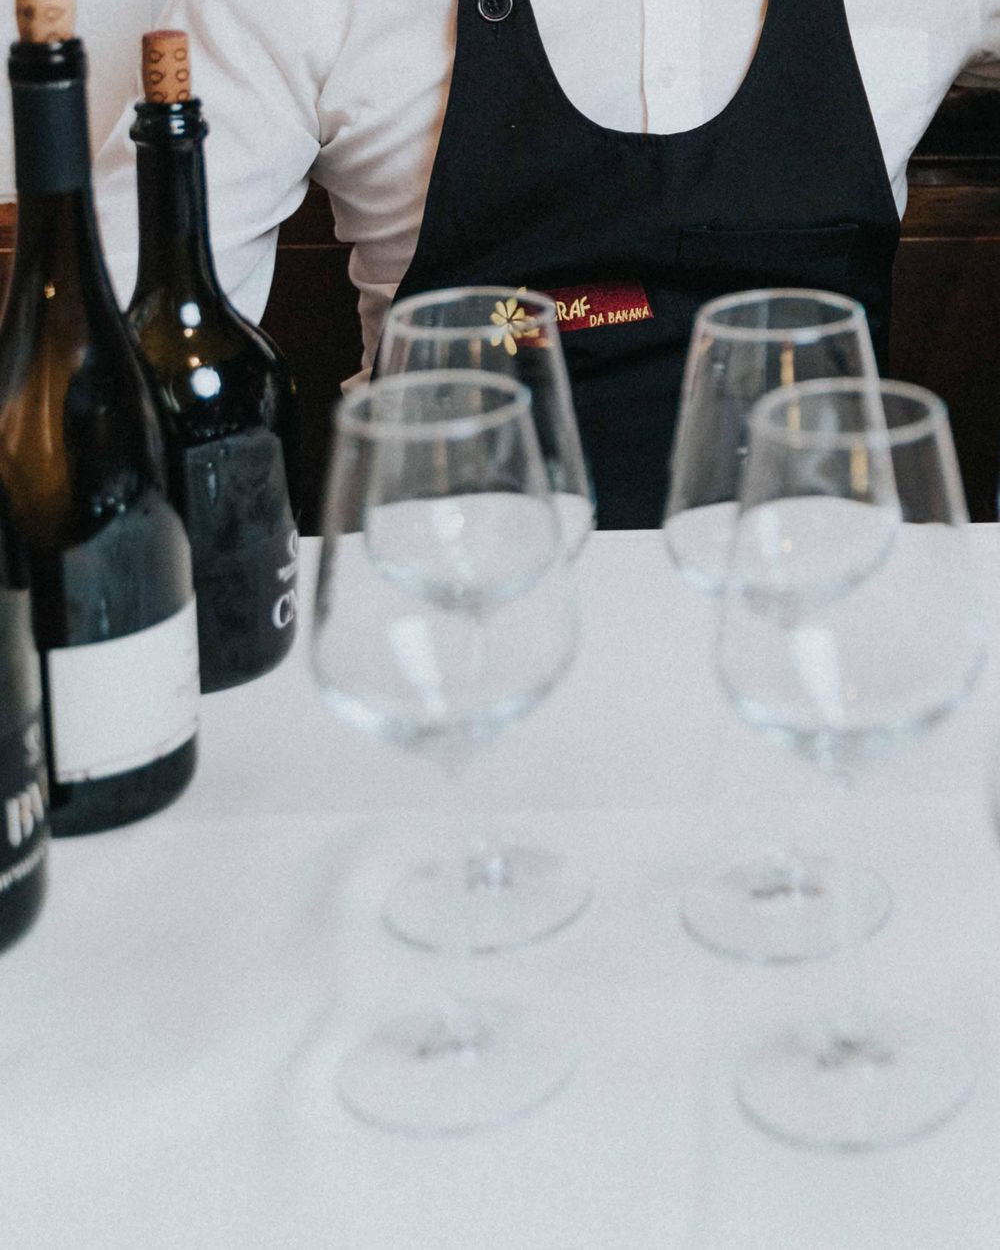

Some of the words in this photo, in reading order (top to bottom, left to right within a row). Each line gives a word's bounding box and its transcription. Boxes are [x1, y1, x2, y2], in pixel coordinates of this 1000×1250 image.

[553, 296, 591, 322] RAF
[589, 313, 605, 327] DA
[608, 306, 649, 324] BANANA
